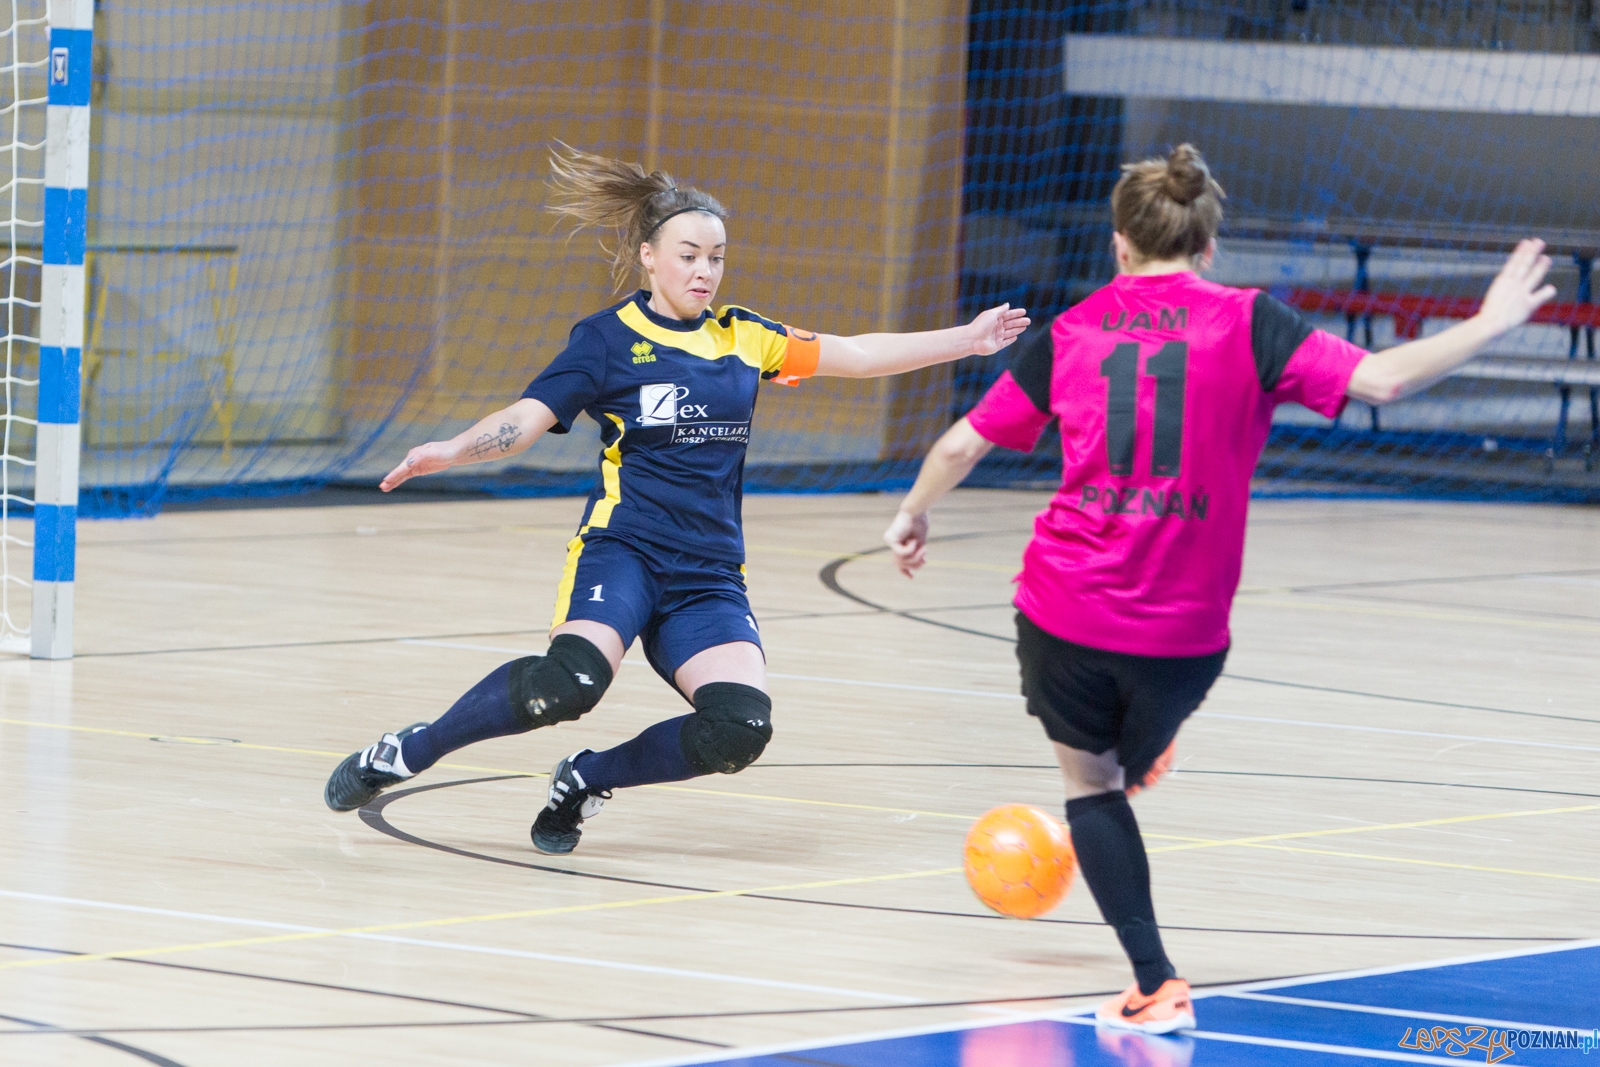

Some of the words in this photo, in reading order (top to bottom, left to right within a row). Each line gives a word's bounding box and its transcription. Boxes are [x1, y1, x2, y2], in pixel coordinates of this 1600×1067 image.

[1102, 307, 1188, 331] UAM
[636, 386, 708, 422] Lex
[1101, 341, 1188, 478] 11
[588, 585, 604, 602] 1
